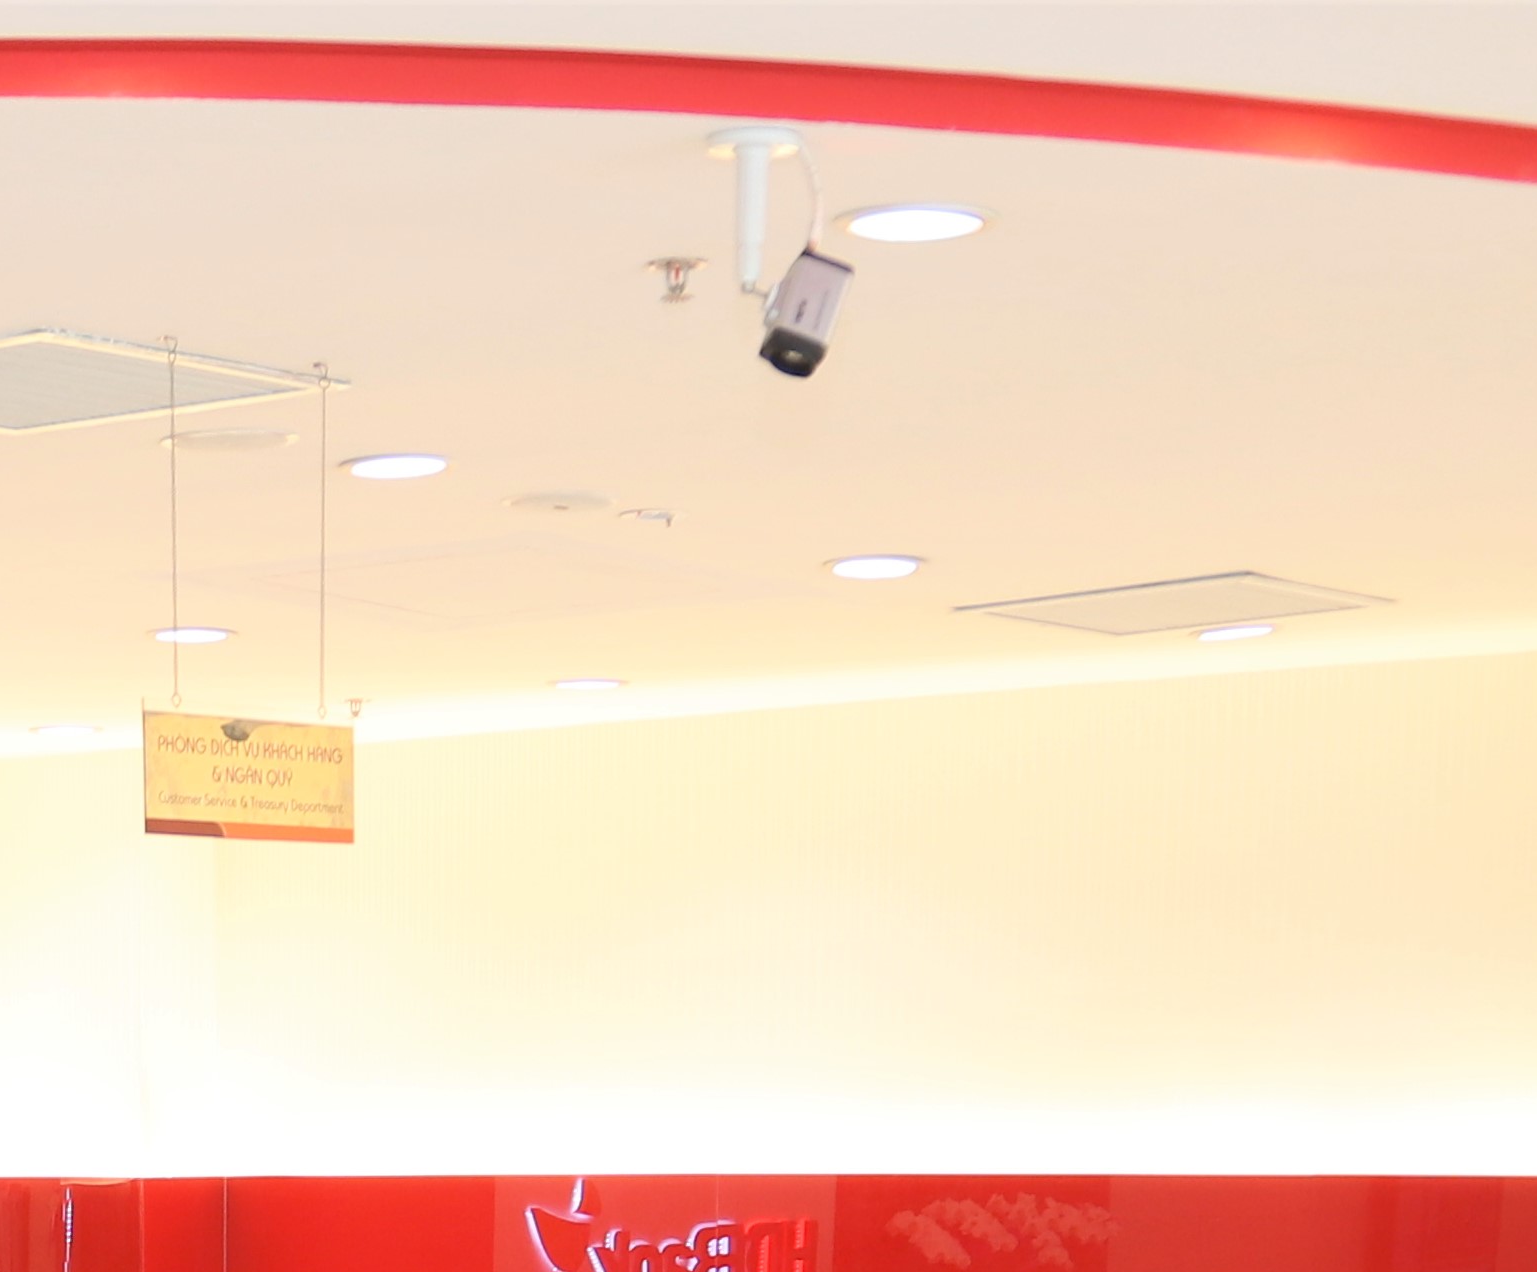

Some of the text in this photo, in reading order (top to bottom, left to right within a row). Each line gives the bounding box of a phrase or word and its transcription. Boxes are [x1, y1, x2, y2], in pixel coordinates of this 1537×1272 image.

[158, 791, 202, 806] Customer
[204, 793, 237, 808] Service
[251, 797, 288, 814] Treasury
[292, 798, 344, 815] Department
